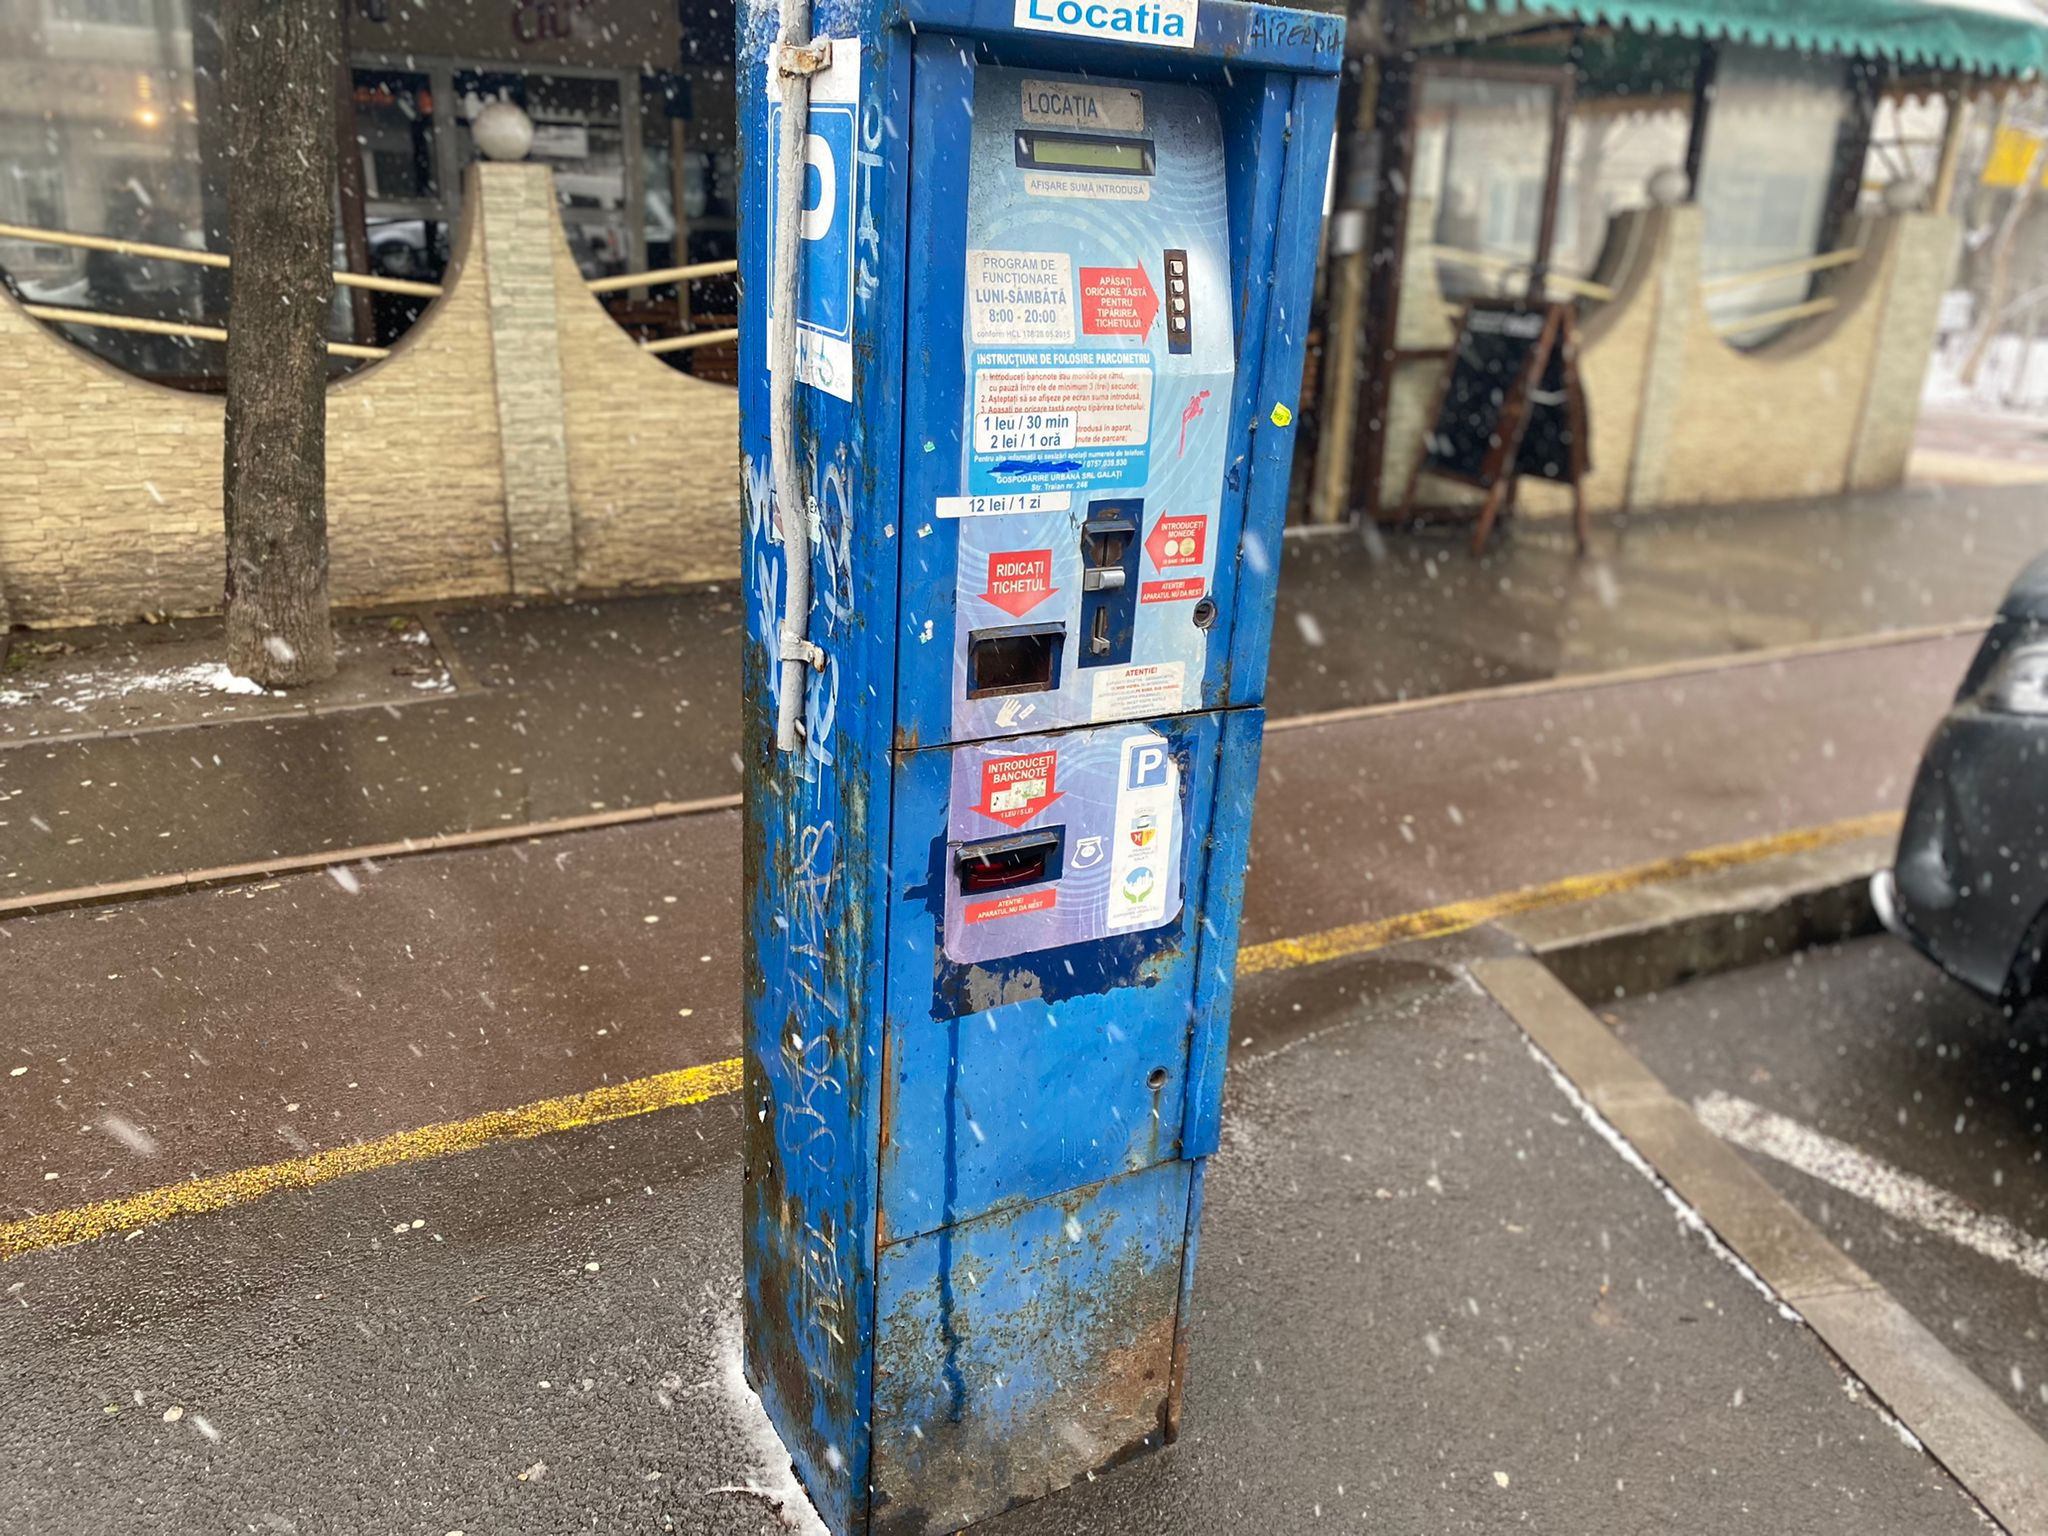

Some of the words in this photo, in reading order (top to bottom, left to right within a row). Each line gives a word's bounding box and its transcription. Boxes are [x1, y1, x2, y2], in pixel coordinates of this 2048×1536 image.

[1029, 0, 1184, 37] Locatia
[983, 257, 1038, 269] PROGRAM
[1041, 259, 1055, 270] DE
[1085, 287, 1121, 296] ORICARE
[1101, 297, 1133, 307] PENTRU
[989, 308, 1014, 323] 8:00
[1024, 309, 1056, 323] 20:00
[1095, 318, 1142, 328] TICHETULUI
[1040, 353, 1052, 364] DE
[1053, 353, 1095, 364] FOLOSIRE
[1096, 353, 1151, 364] PARCOMETRU
[984, 416, 990, 430] 1
[995, 416, 1015, 431] leu
[1018, 415, 1023, 430] /
[1026, 415, 1042, 429] 30
[1045, 414, 1069, 429] min
[991, 434, 998, 449] 2
[1002, 434, 1018, 448] lei
[1020, 433, 1026, 447] /
[1029, 433, 1036, 447] 1
[1040, 432, 1061, 447] oră
[1081, 471, 1096, 480] SRL
[1044, 482, 1064, 491] Traian
[969, 498, 985, 512] 12
[990, 497, 1005, 511] lei
[1009, 496, 1014, 510] /
[1018, 496, 1024, 509] 1
[1030, 495, 1041, 509] zi
[1168, 529, 1196, 538] MONEDE
[992, 578, 1046, 595] TICHETUL
[1136, 748, 1163, 785] P
[993, 767, 1048, 784] BANCNOTE
[977, 908, 1008, 919] APARATUL
